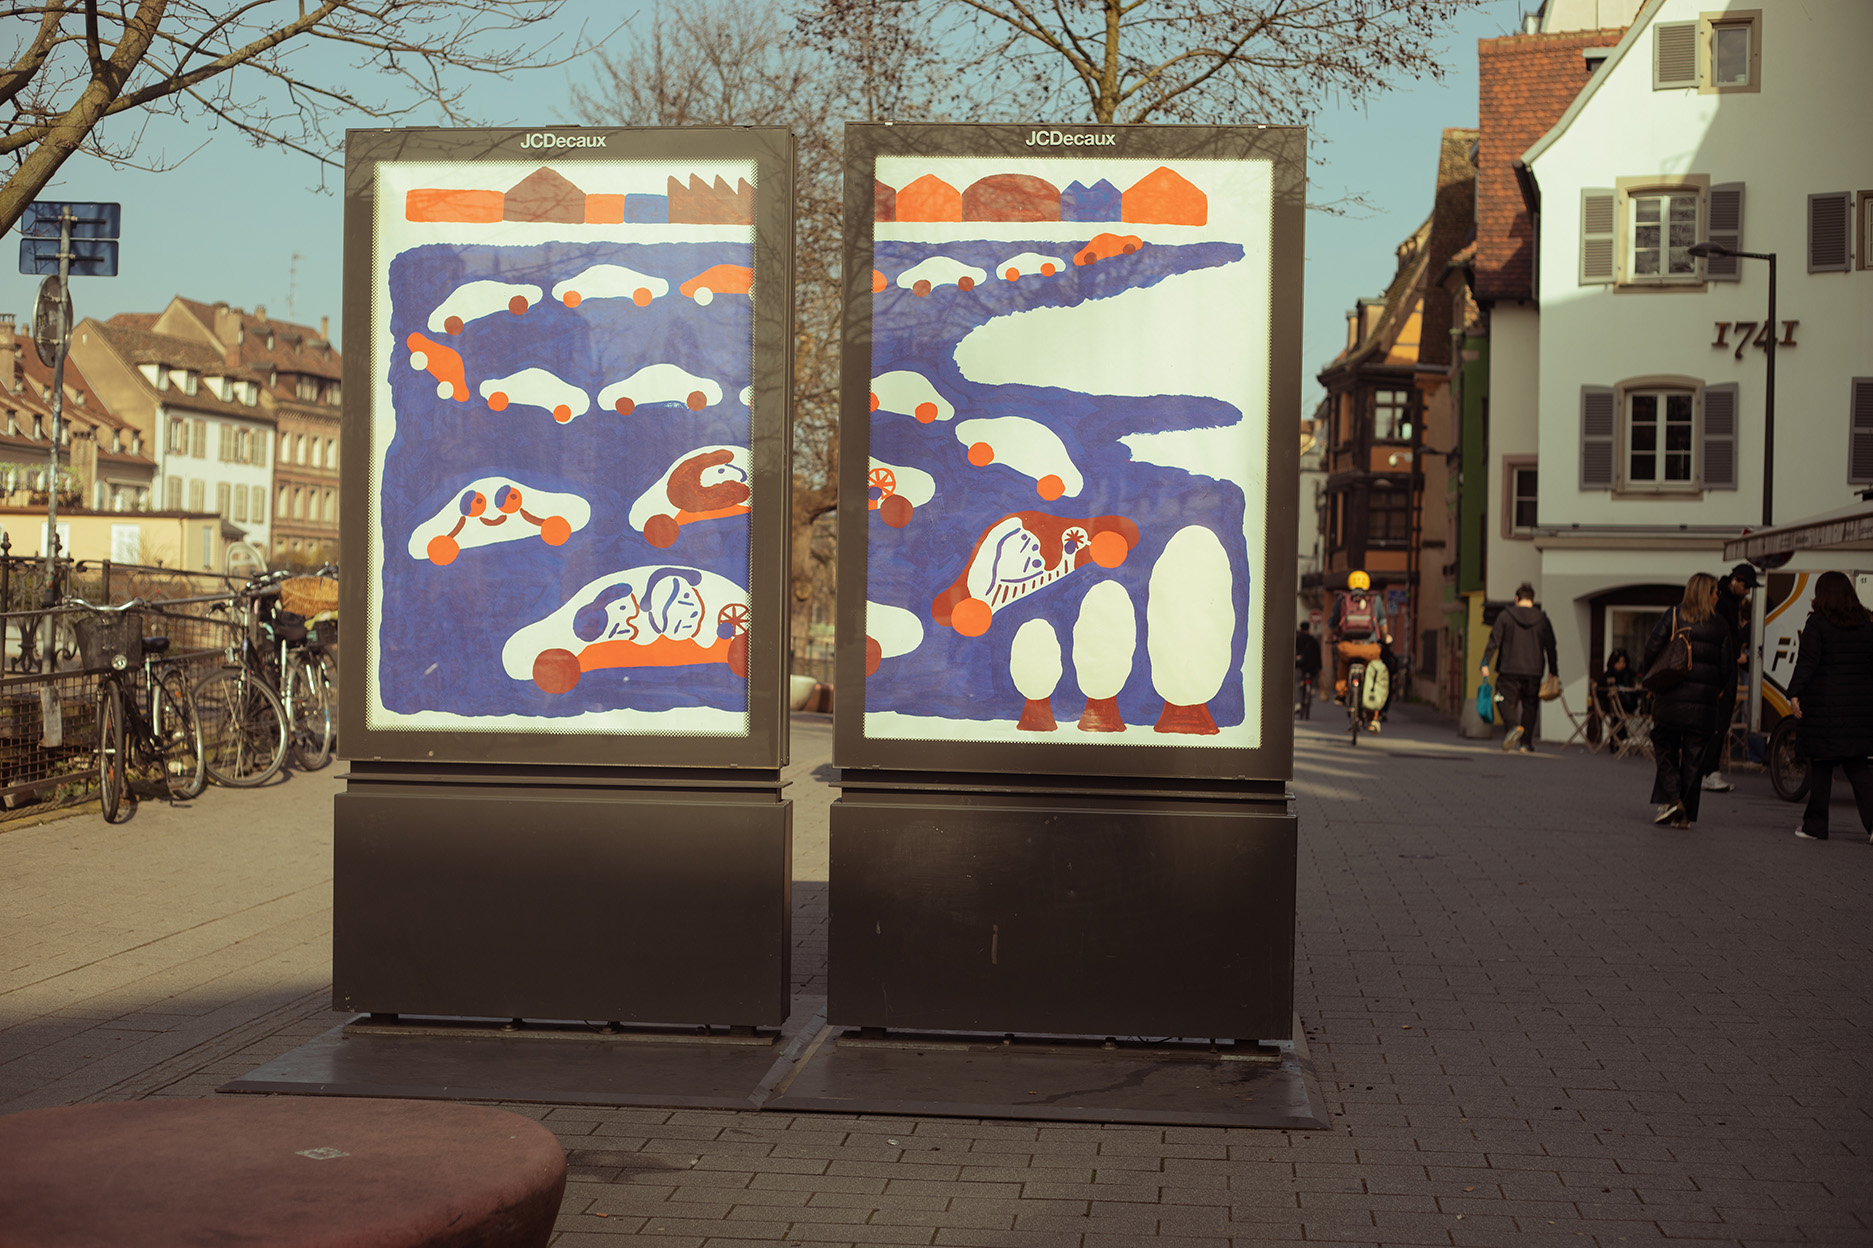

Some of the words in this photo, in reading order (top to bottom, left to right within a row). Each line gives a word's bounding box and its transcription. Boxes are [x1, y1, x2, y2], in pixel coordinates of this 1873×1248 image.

[520, 133, 607, 149] JCDecaux
[1025, 130, 1116, 147] JCDecaux
[1711, 319, 1800, 360] 1741
